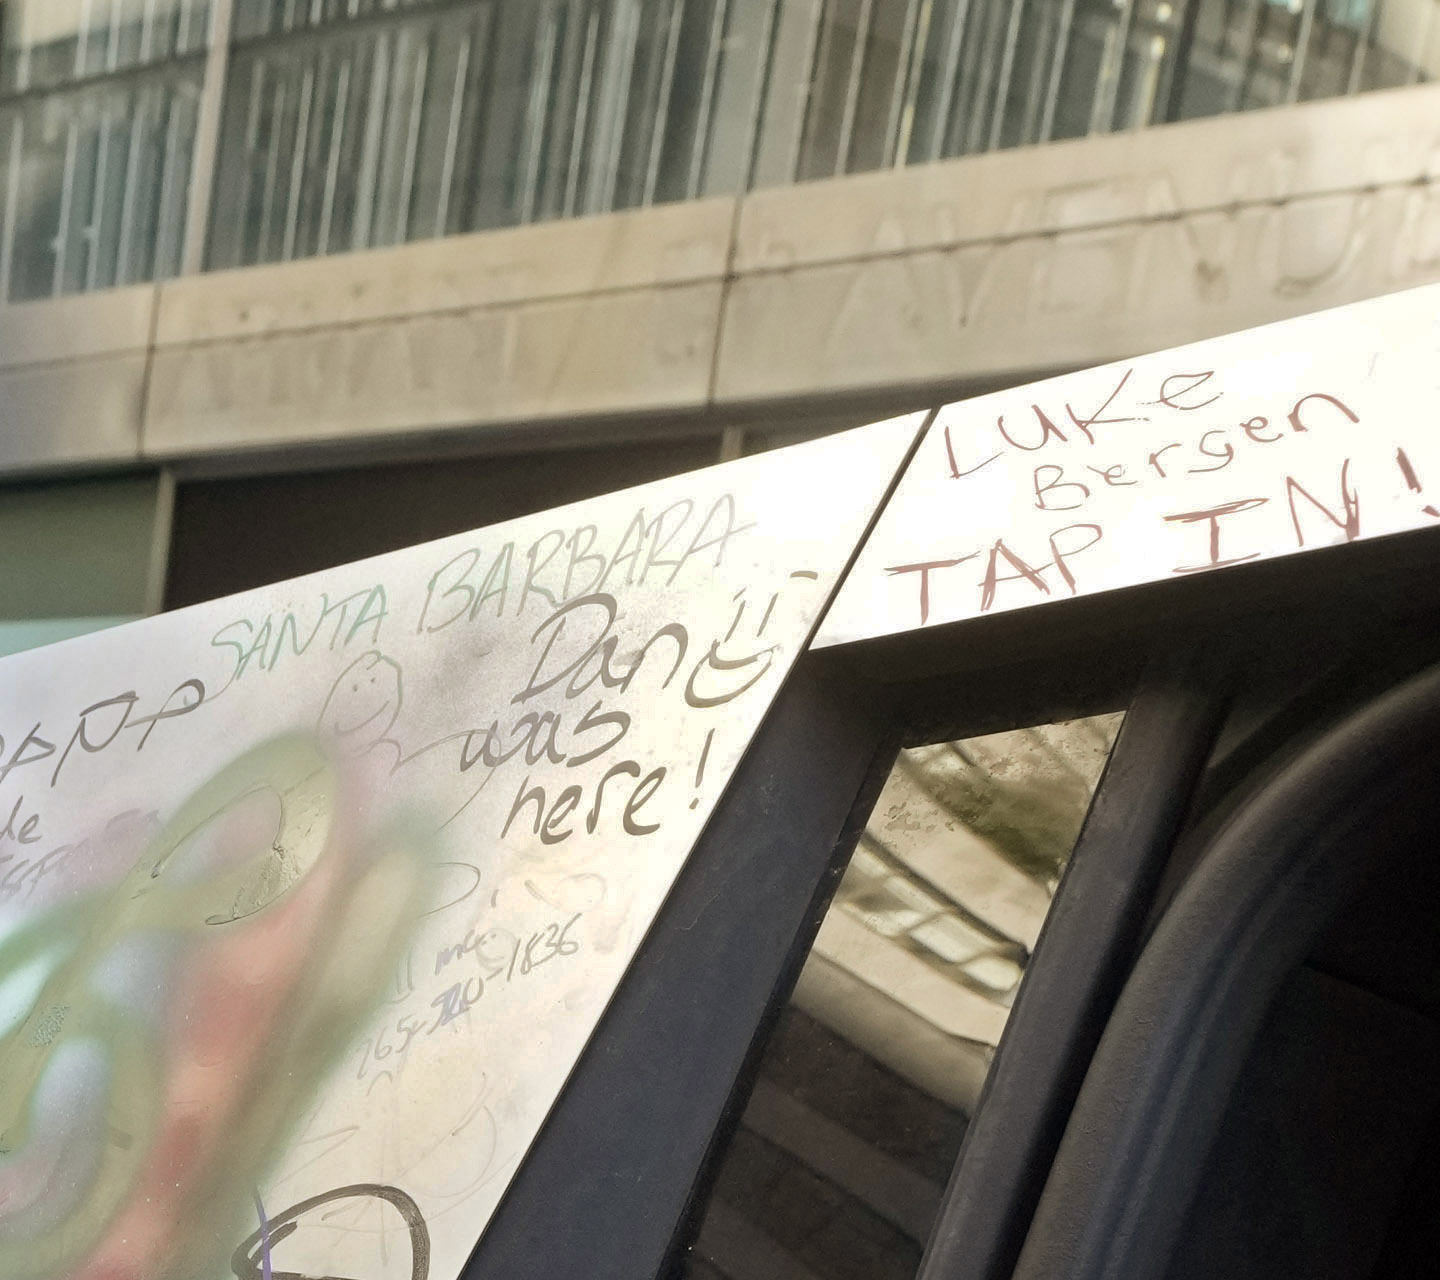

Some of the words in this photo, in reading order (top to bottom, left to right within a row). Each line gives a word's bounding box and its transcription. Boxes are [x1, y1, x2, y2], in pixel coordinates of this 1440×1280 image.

[211, 583, 389, 702] SANTA
[417, 492, 757, 633] BARBARA
[885, 522, 1103, 626] TAP
[511, 592, 690, 704] Dan
[457, 700, 633, 775] was
